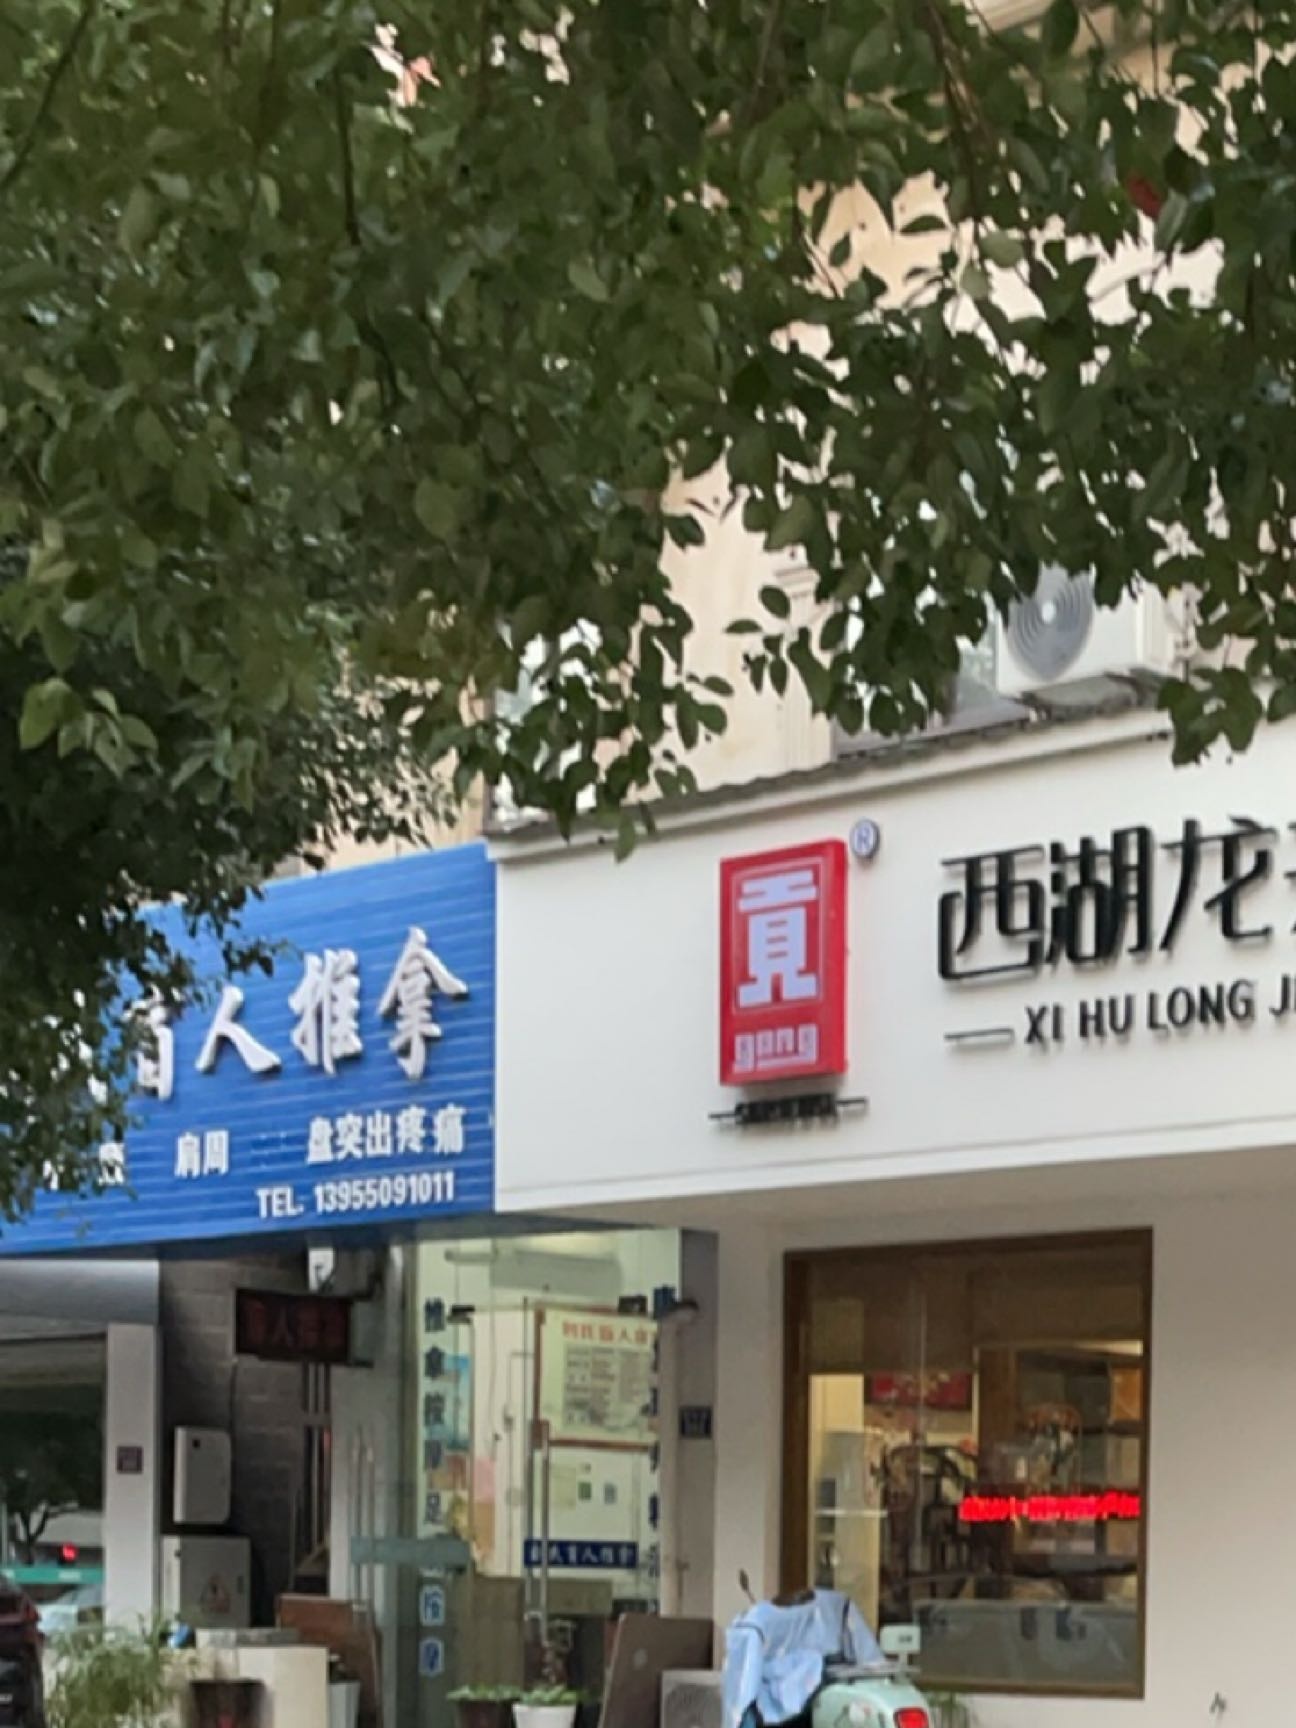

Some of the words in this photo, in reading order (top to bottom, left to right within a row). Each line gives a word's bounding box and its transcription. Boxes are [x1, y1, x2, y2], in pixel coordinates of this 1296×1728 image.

[1025, 1004, 1064, 1044] XI
[1079, 995, 1133, 1038] HU
[1149, 979, 1258, 1031] LONG
[314, 1169, 455, 1215] 13955091011
